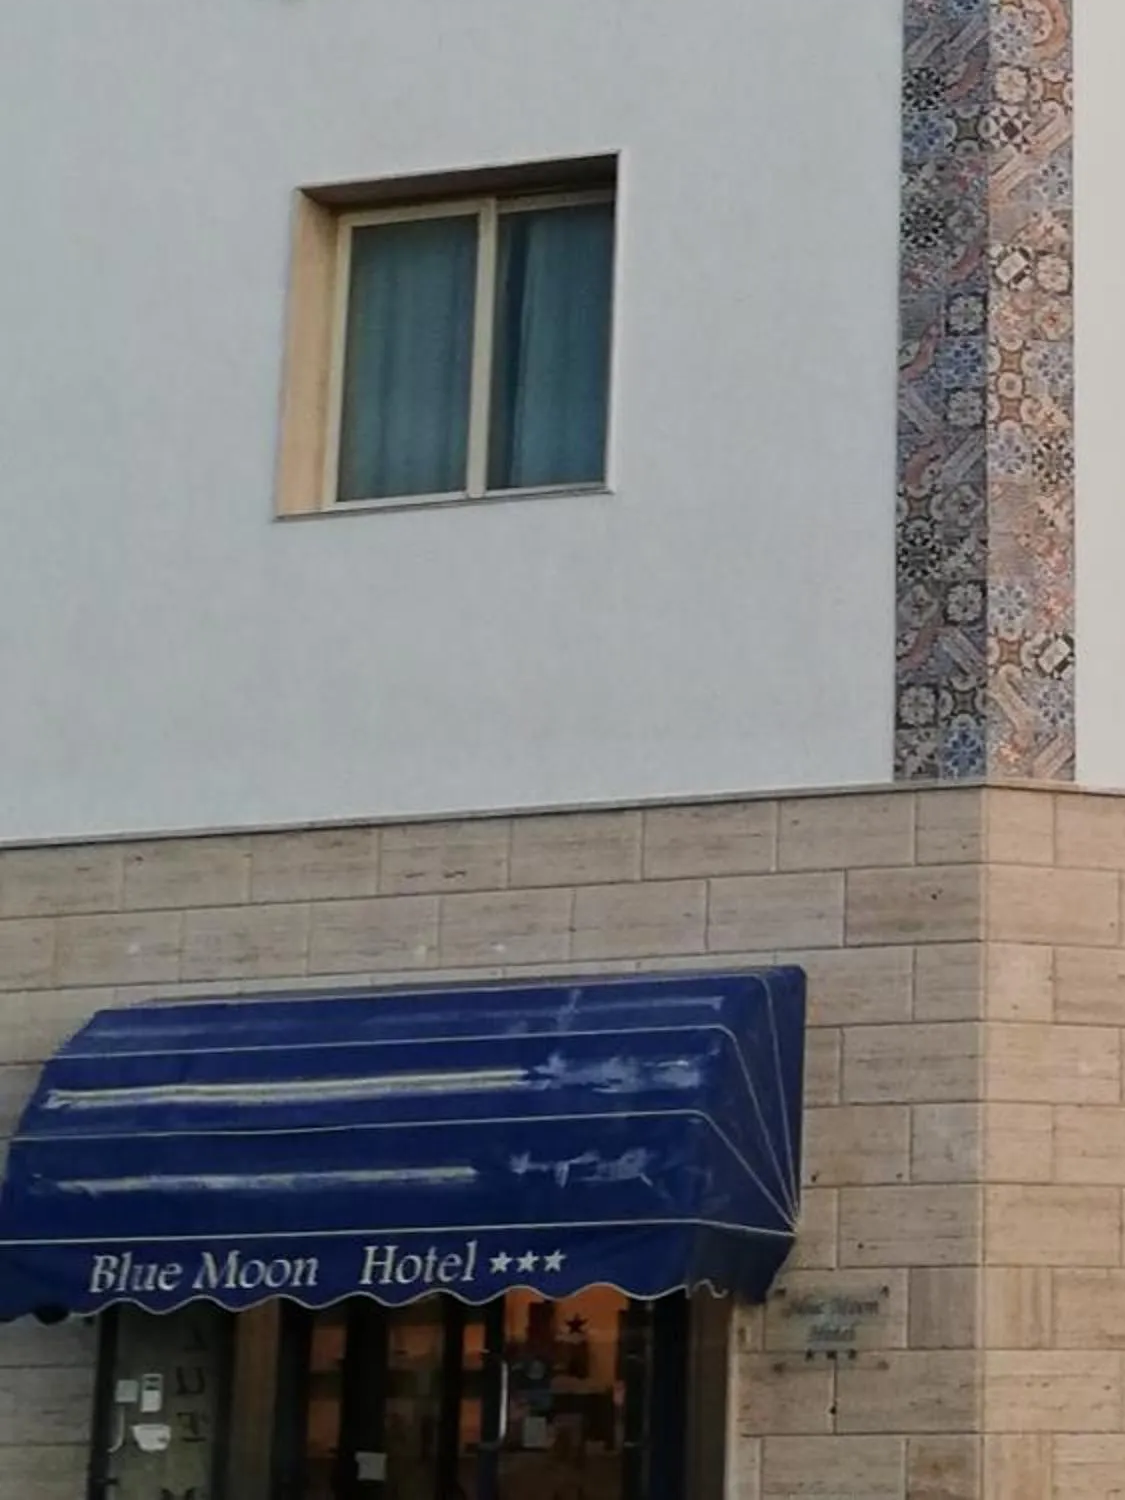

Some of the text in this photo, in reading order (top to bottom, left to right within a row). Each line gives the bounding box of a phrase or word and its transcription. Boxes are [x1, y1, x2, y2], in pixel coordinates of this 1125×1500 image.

[90, 1241, 478, 1294] Blue Moon Hotel
